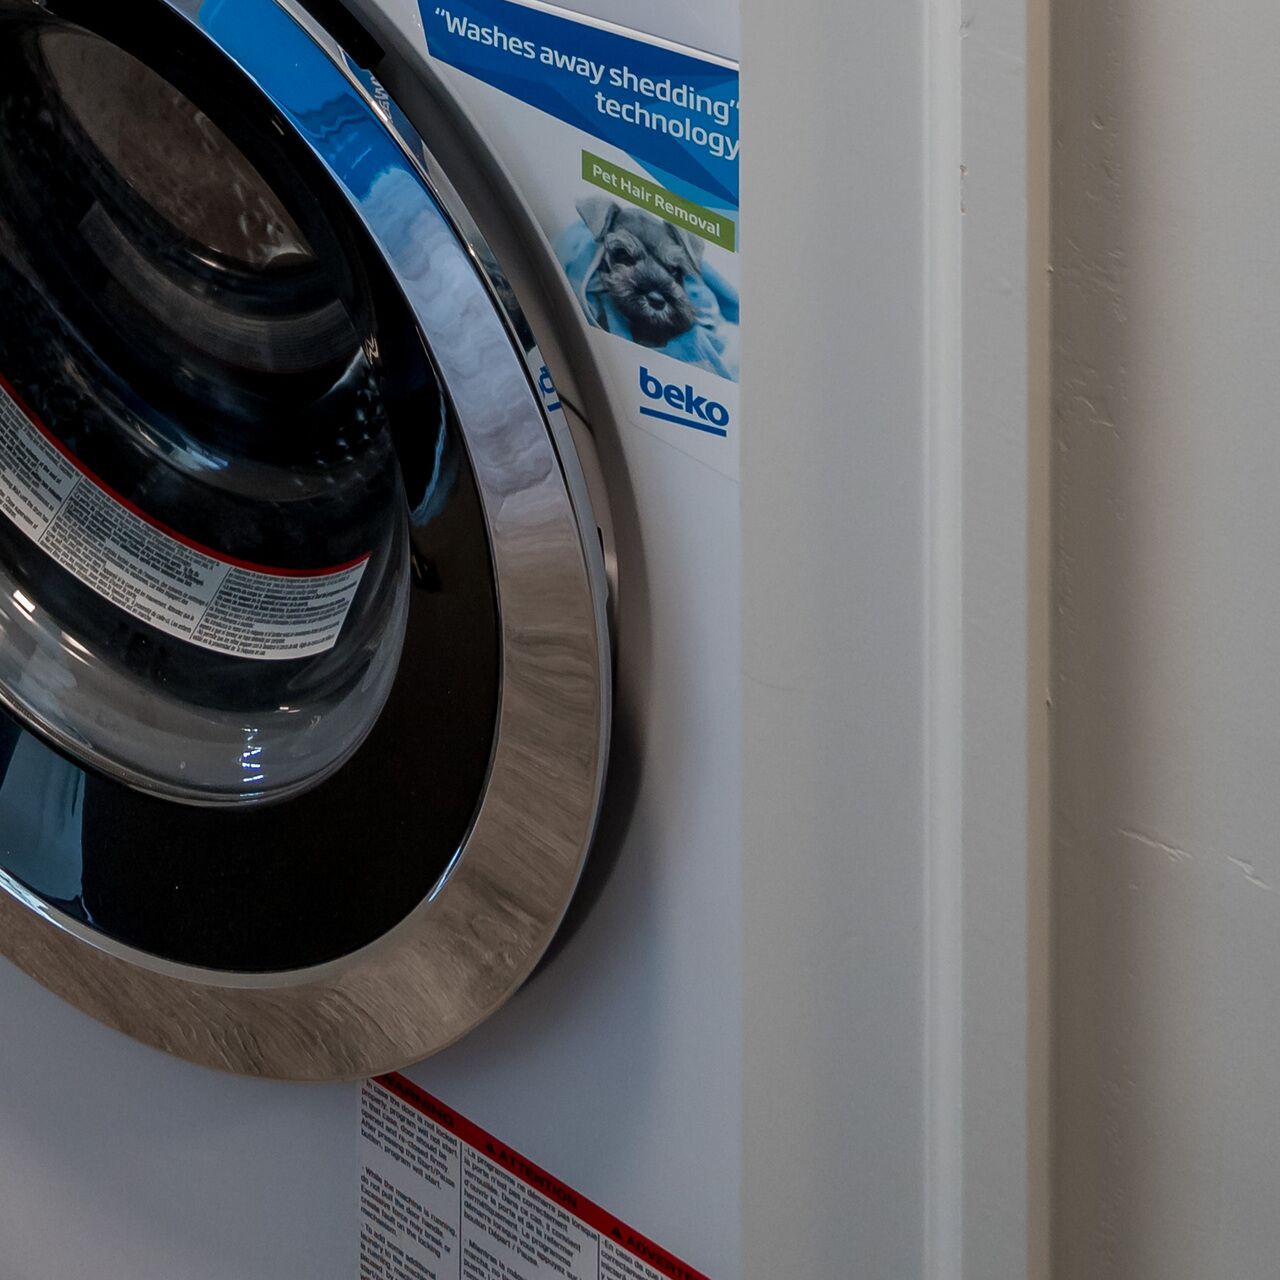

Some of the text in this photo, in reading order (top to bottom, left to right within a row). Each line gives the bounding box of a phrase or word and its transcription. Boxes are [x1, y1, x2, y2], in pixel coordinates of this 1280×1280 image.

[435, 7, 536, 60] "Washes
[539, 46, 605, 85] away
[594, 91, 739, 160] technology
[592, 164, 720, 237] Pet Hair Removal
[639, 366, 730, 427] beko
